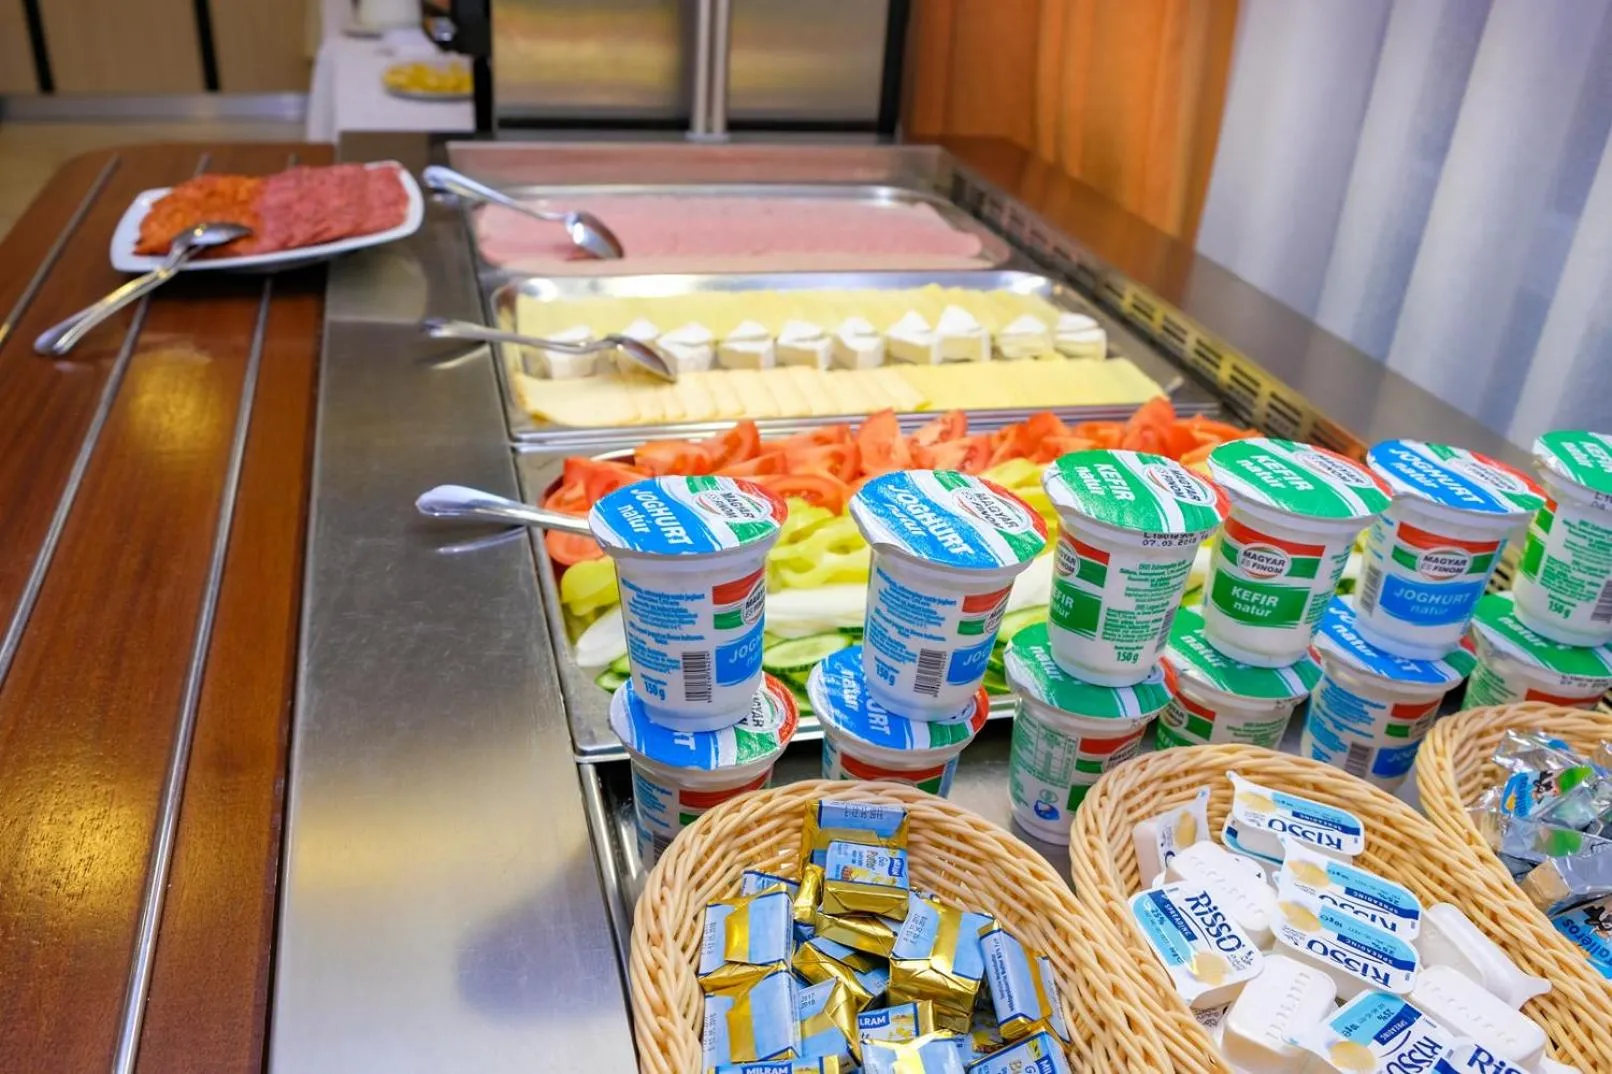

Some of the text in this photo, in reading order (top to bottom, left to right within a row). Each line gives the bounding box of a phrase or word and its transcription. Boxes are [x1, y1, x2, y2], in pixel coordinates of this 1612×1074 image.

[1094, 463, 1135, 501] KEFIR
[1236, 459, 1286, 489] natúr
[1251, 454, 1315, 492] KEFIR
[1389, 447, 1484, 504] JOGHURT
[617, 504, 651, 535] natúr
[630, 488, 694, 546] JOGHURT
[886, 484, 975, 555] JOGHURT
[1243, 550, 1286, 567] MAGYAR
[1252, 562, 1283, 574] FINOM
[1423, 555, 1468, 566] MAGYAR
[1432, 565, 1465, 574] FINOM
[1231, 586, 1280, 607] KEFIR
[1233, 600, 1272, 617] natúr
[1393, 588, 1472, 606] JOGHURT
[1180, 634, 1228, 669] natúr
[1332, 623, 1378, 659] natúr
[1116, 652, 1139, 664] 150 g
[859, 1015, 886, 1027] LRAM
